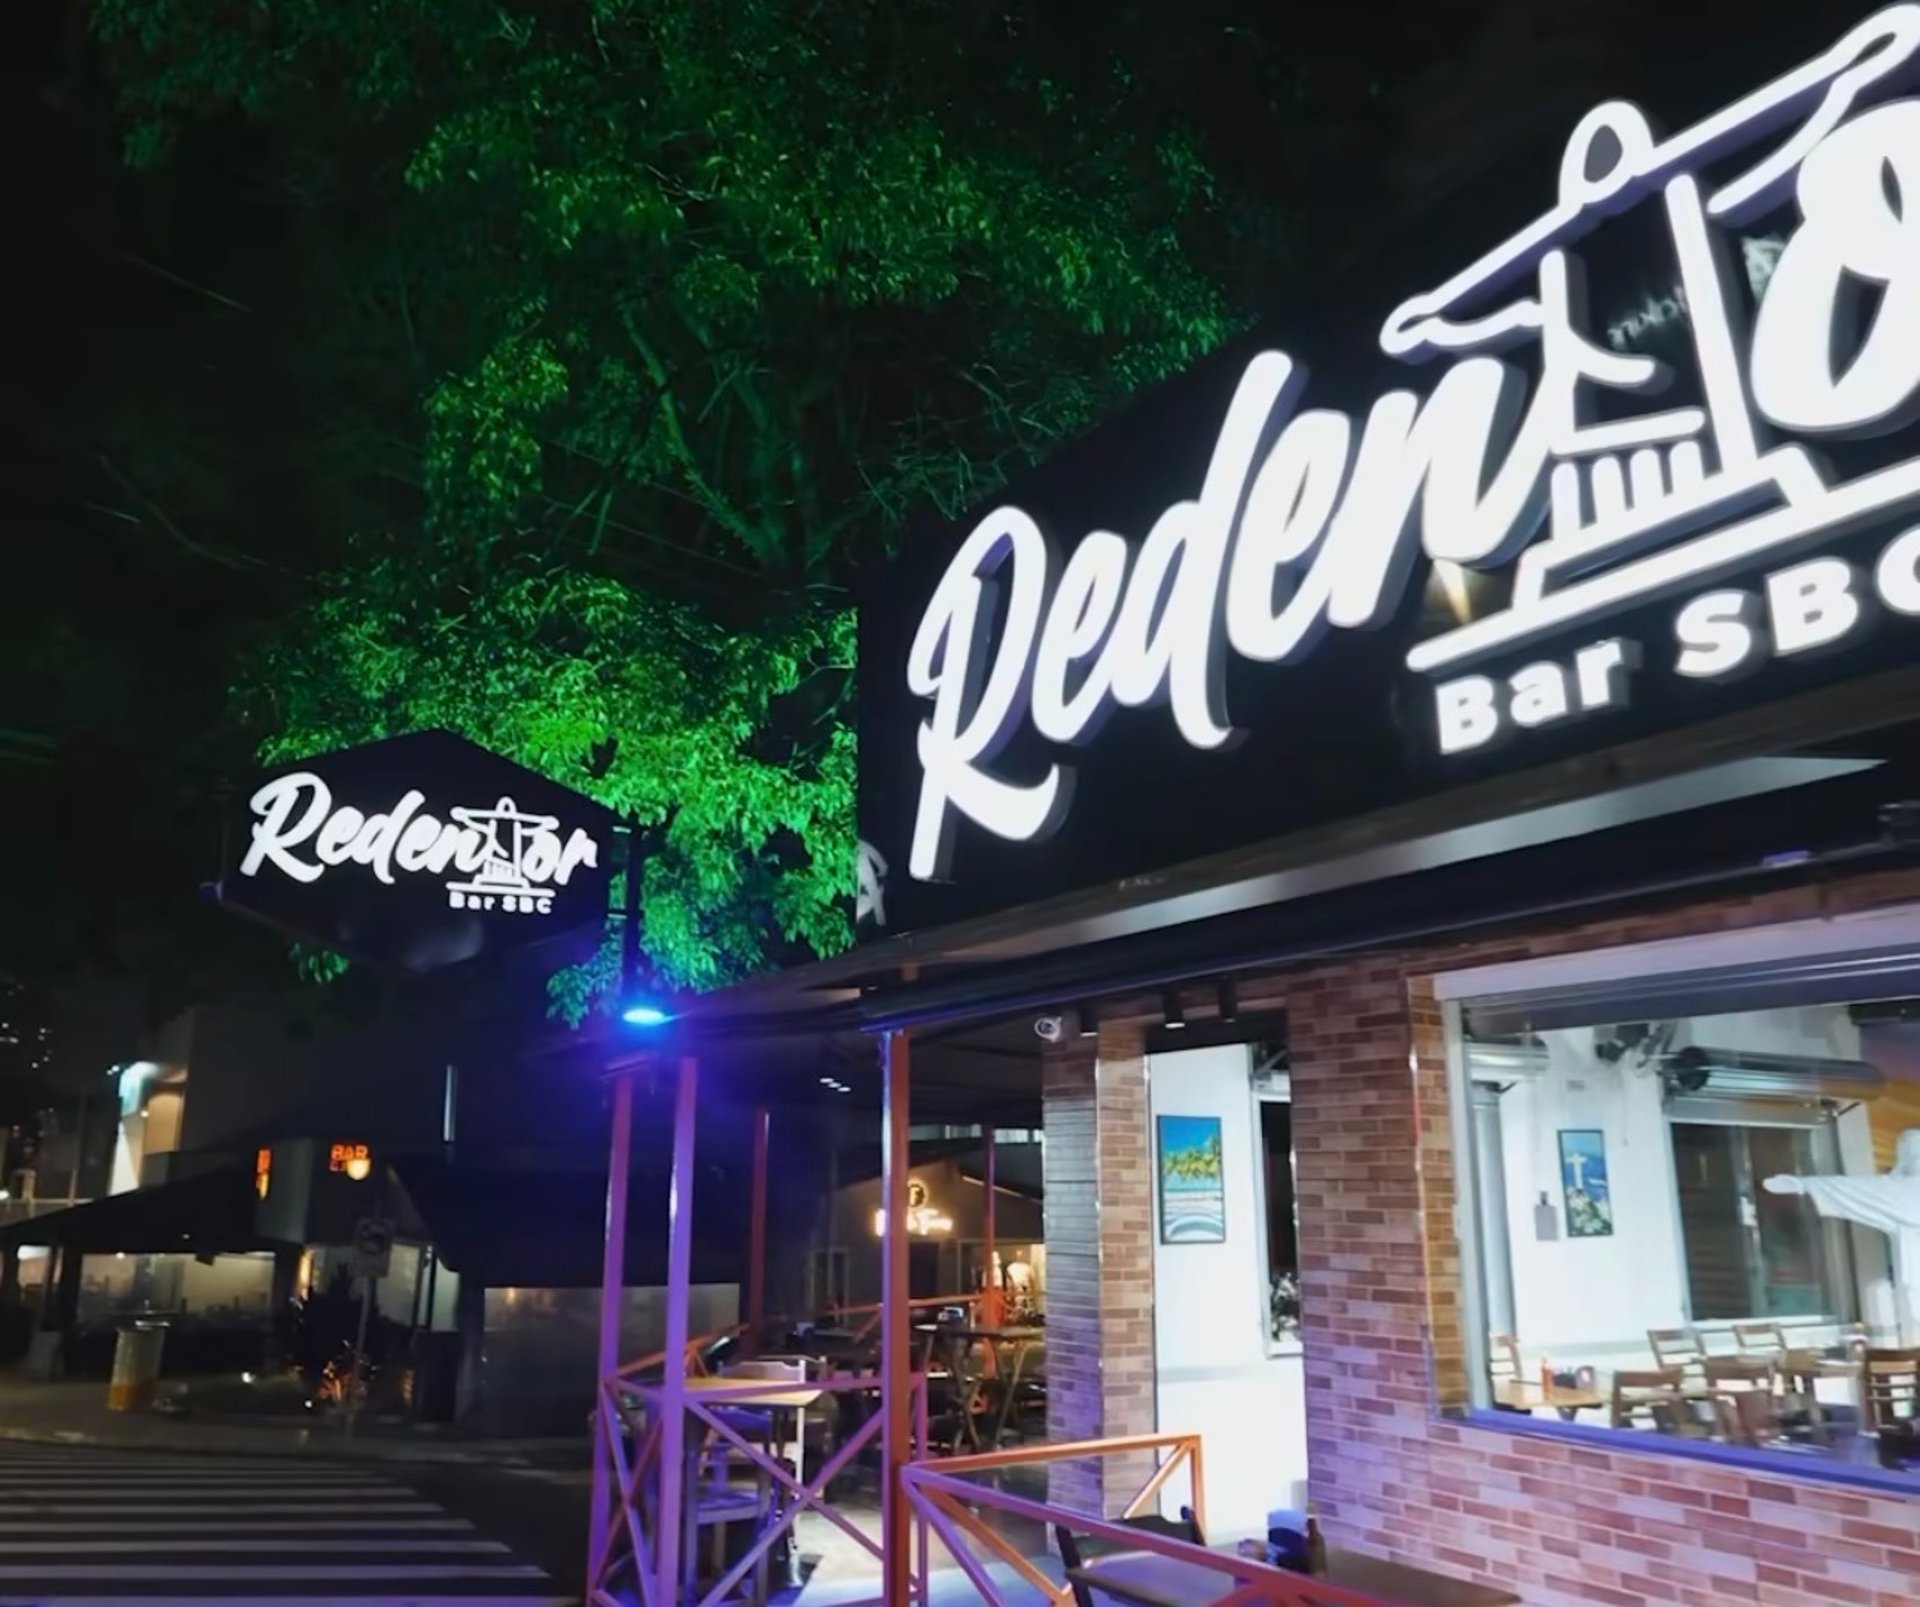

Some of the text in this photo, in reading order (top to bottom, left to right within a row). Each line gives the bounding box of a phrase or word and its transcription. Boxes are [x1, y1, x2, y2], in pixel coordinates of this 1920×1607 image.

[1436, 642, 1622, 753] Bar
[240, 771, 598, 891] Redentor
[449, 891, 495, 910] Bar
[330, 1143, 369, 1161] BAR
